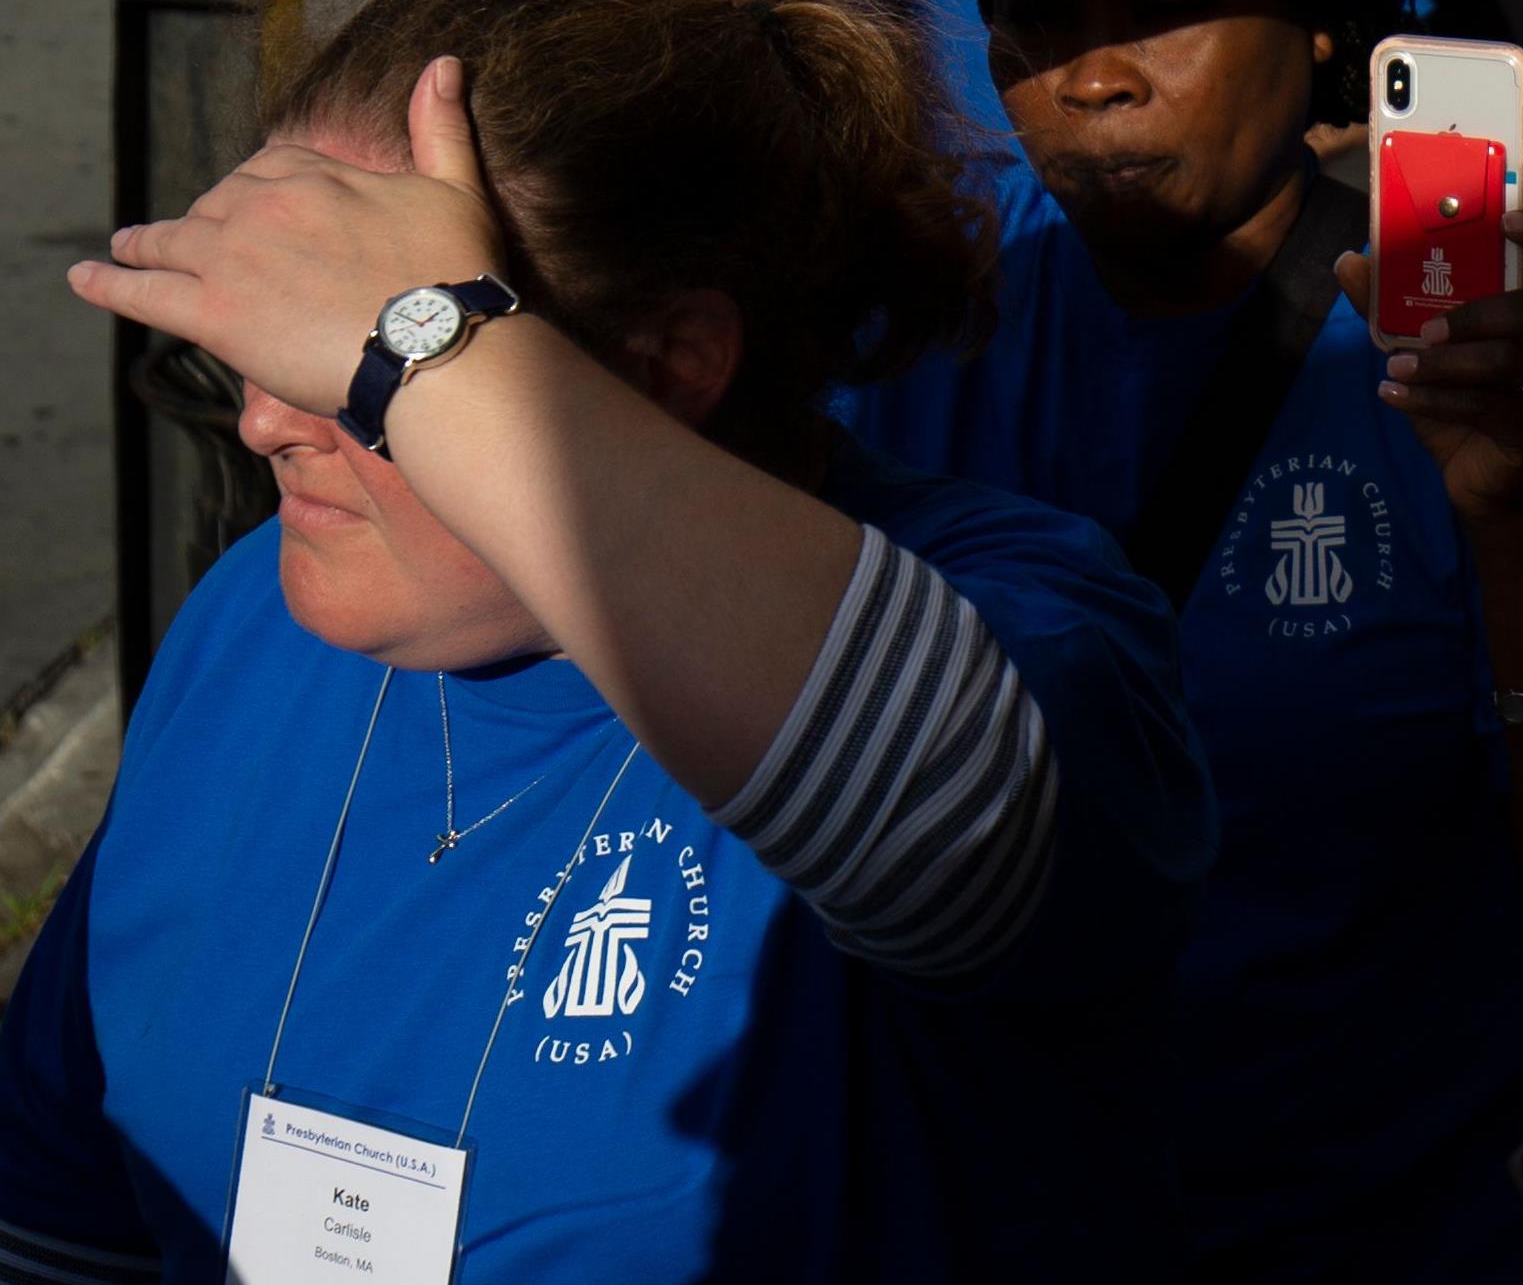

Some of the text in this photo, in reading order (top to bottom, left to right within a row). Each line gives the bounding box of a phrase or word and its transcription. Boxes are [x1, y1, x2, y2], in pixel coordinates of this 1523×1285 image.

[1220, 453, 1394, 596] PRESBYTERIAN CHURCH
[1267, 614, 1352, 638] (USA)
[505, 818, 709, 1006] PRESBTERN CHURCH
[535, 1031, 632, 1064] (USA)
[285, 1123, 436, 1178] Presbyterian Church (U.S.A.)
[332, 1187, 370, 1212] Kate
[323, 1217, 372, 1243] Carlisle
[314, 1246, 374, 1273] Boston, MA
